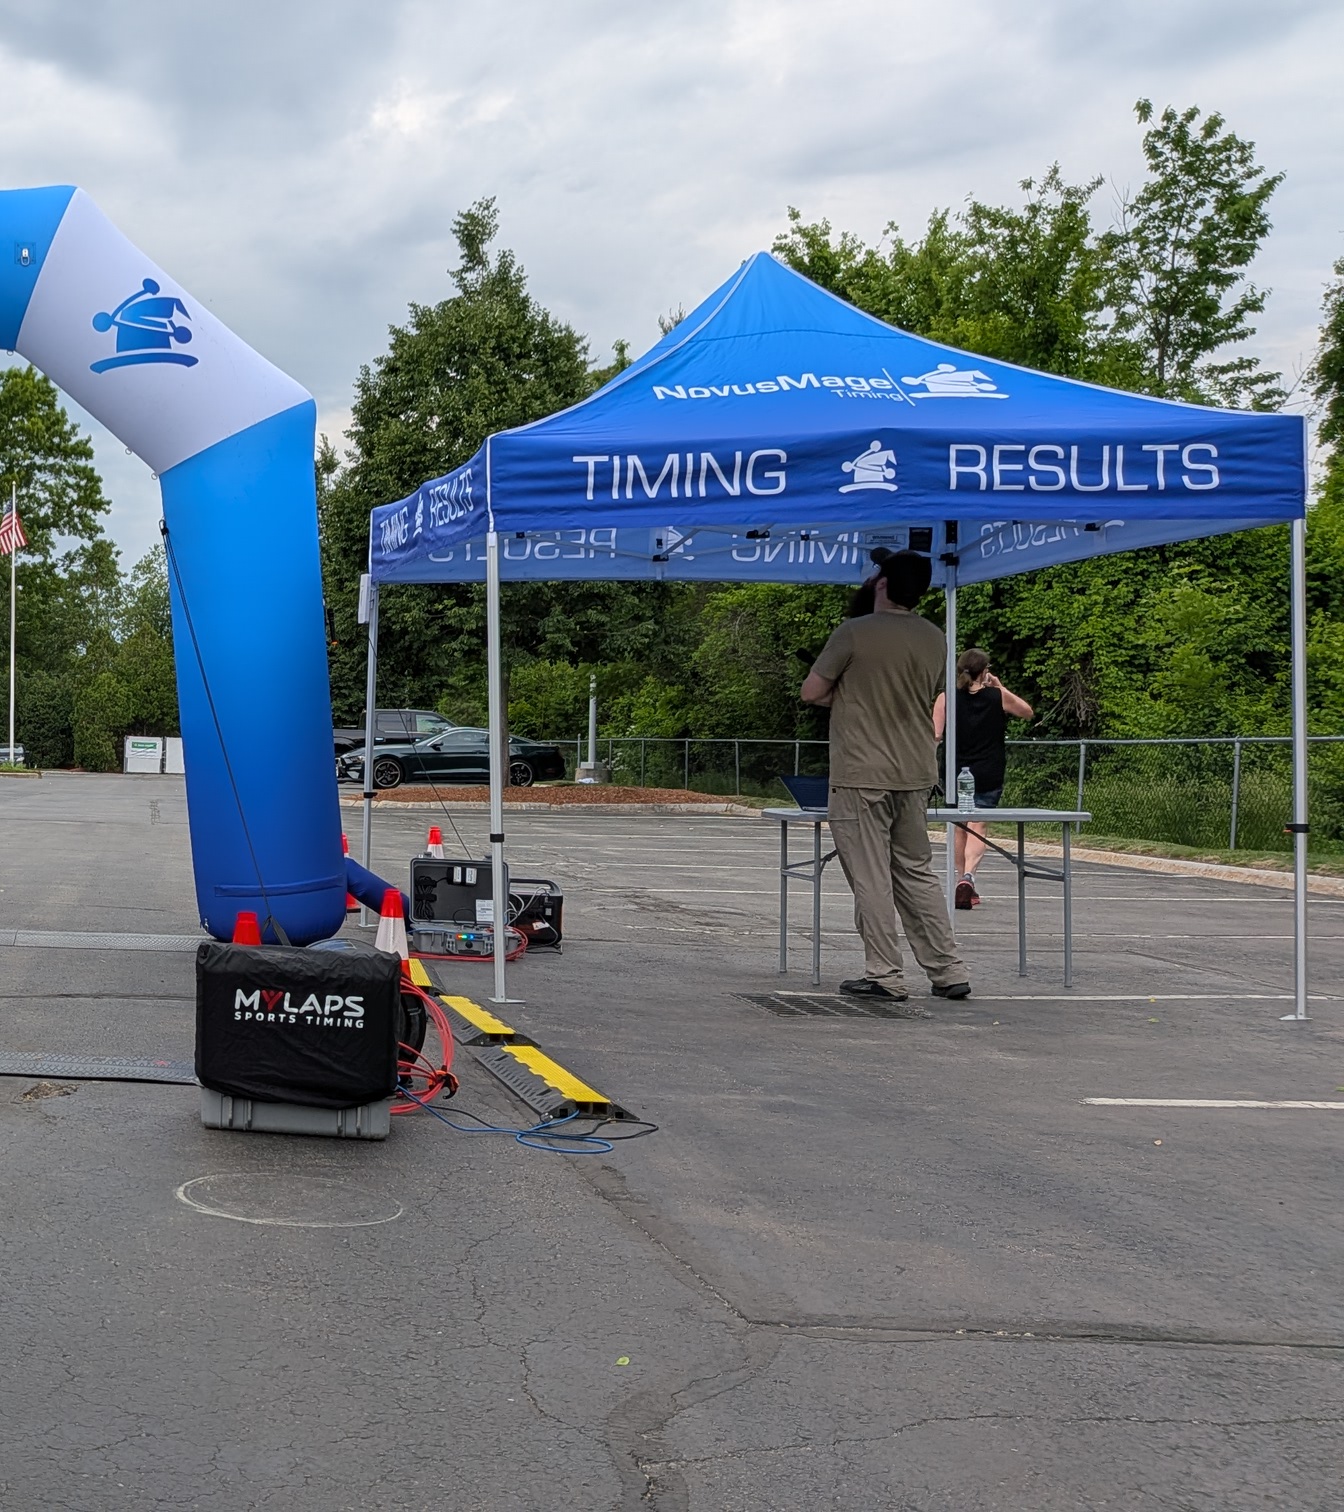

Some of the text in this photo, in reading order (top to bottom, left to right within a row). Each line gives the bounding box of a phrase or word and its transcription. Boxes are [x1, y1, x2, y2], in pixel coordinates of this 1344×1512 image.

[652, 373, 893, 400] NovusMage
[831, 389, 904, 402] Timing
[572, 443, 1220, 500] TIMING RESULTS
[380, 467, 474, 556] TIMING RESULTS
[234, 988, 365, 1018] MYLAPS
[234, 1011, 364, 1029] SPORTS TIMING
